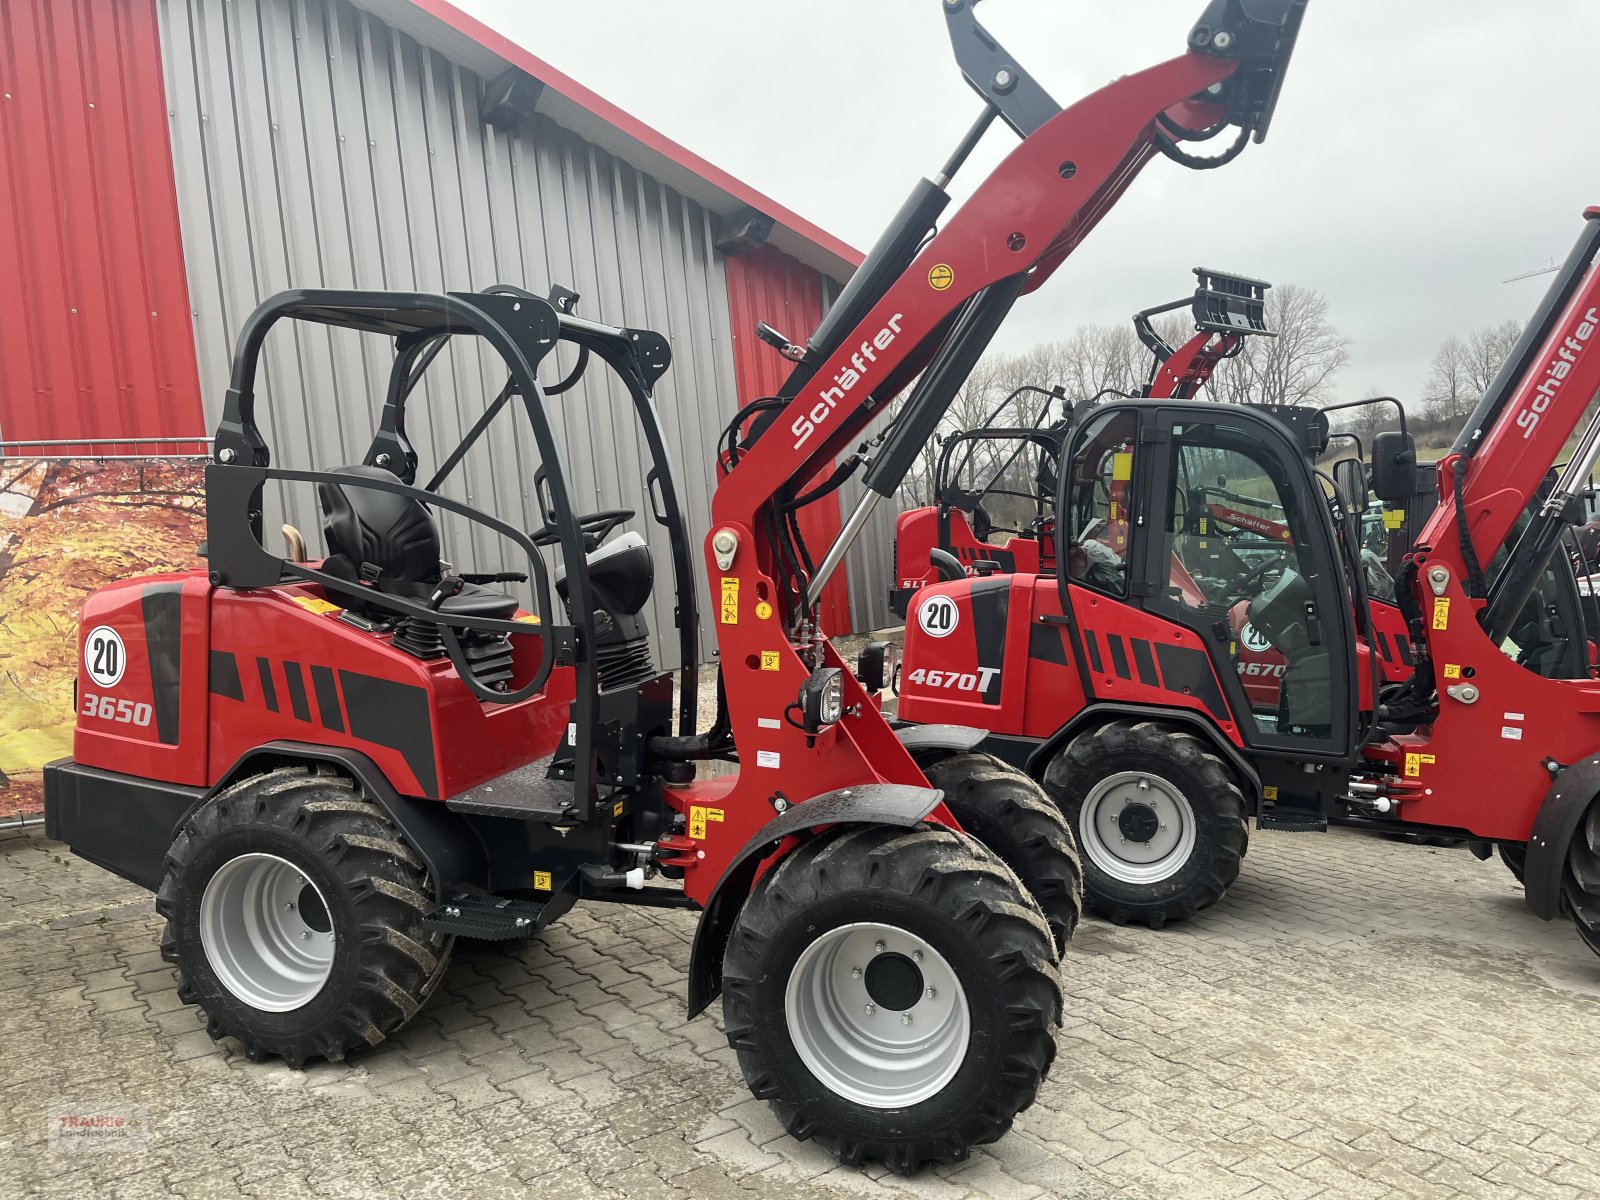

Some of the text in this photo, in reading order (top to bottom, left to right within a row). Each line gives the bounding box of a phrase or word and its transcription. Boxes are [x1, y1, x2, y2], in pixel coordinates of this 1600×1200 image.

[791, 313, 902, 450] Schäffer
[1516, 307, 1599, 439] Schäffer
[1228, 513, 1271, 531] Schäffer
[926, 603, 951, 629] 20
[93, 638, 117, 676] 20
[908, 666, 1001, 693] 4670T
[81, 693, 152, 726] 3650
